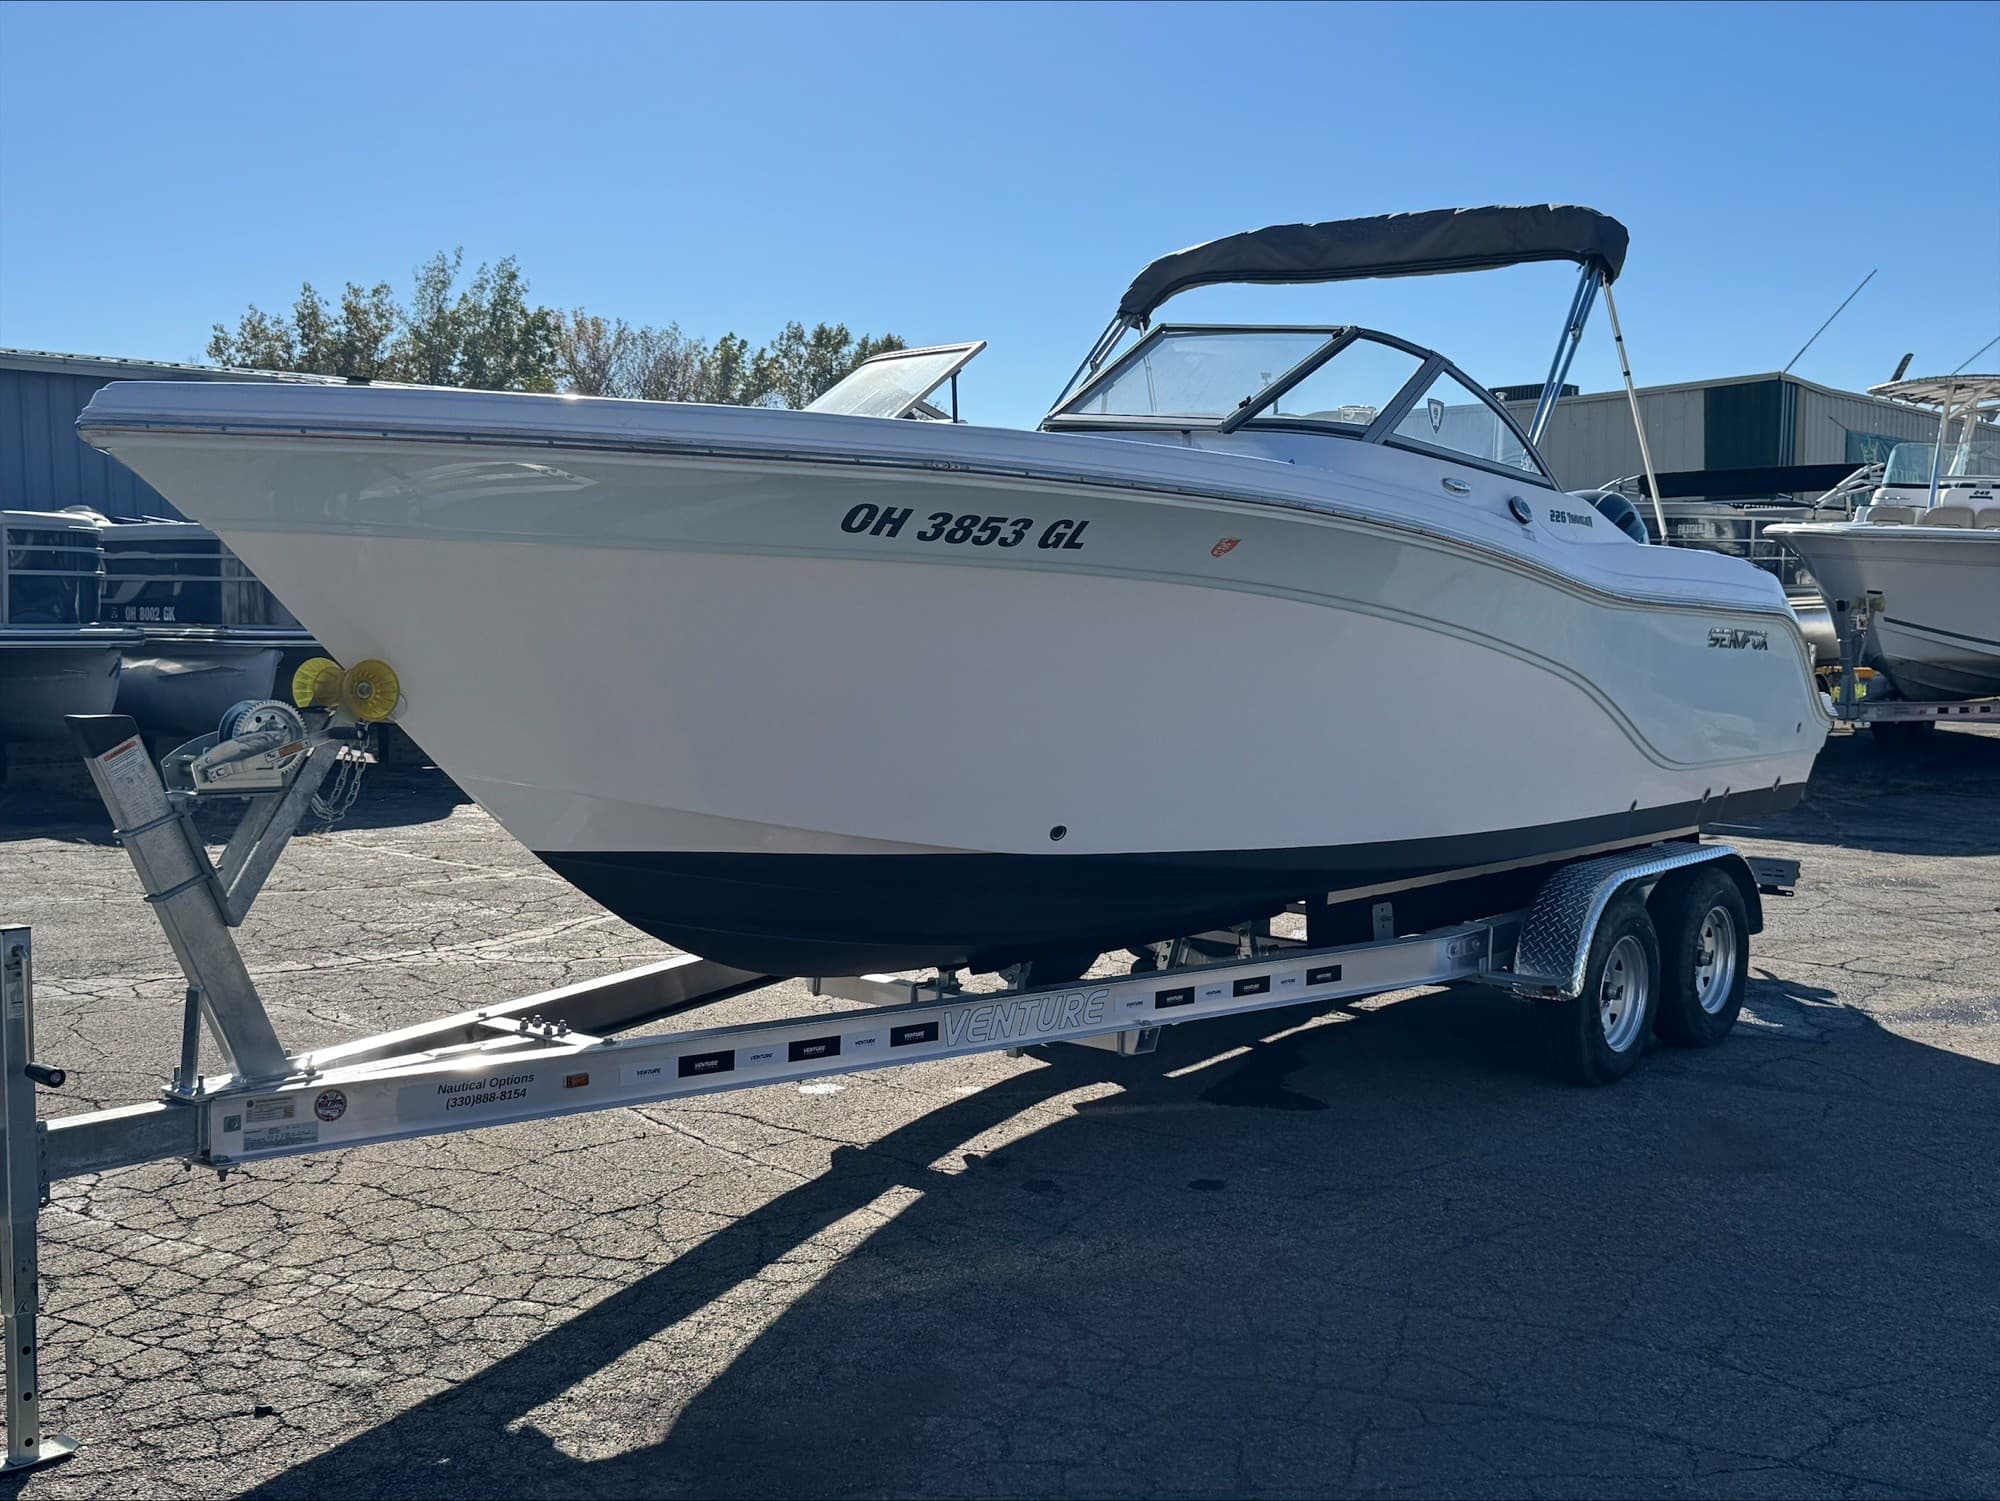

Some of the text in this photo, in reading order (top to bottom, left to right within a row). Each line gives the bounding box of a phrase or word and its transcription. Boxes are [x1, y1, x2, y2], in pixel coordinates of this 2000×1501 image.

[841, 503, 1090, 549] OH 3853 GL
[1550, 509, 1567, 524] 226
[125, 606, 137, 621] OH
[139, 606, 161, 621] 8002
[944, 988, 1110, 1048] VENTURE
[437, 1073, 535, 1095] Nautical Options
[446, 1087, 527, 1111] (330)888-8154
